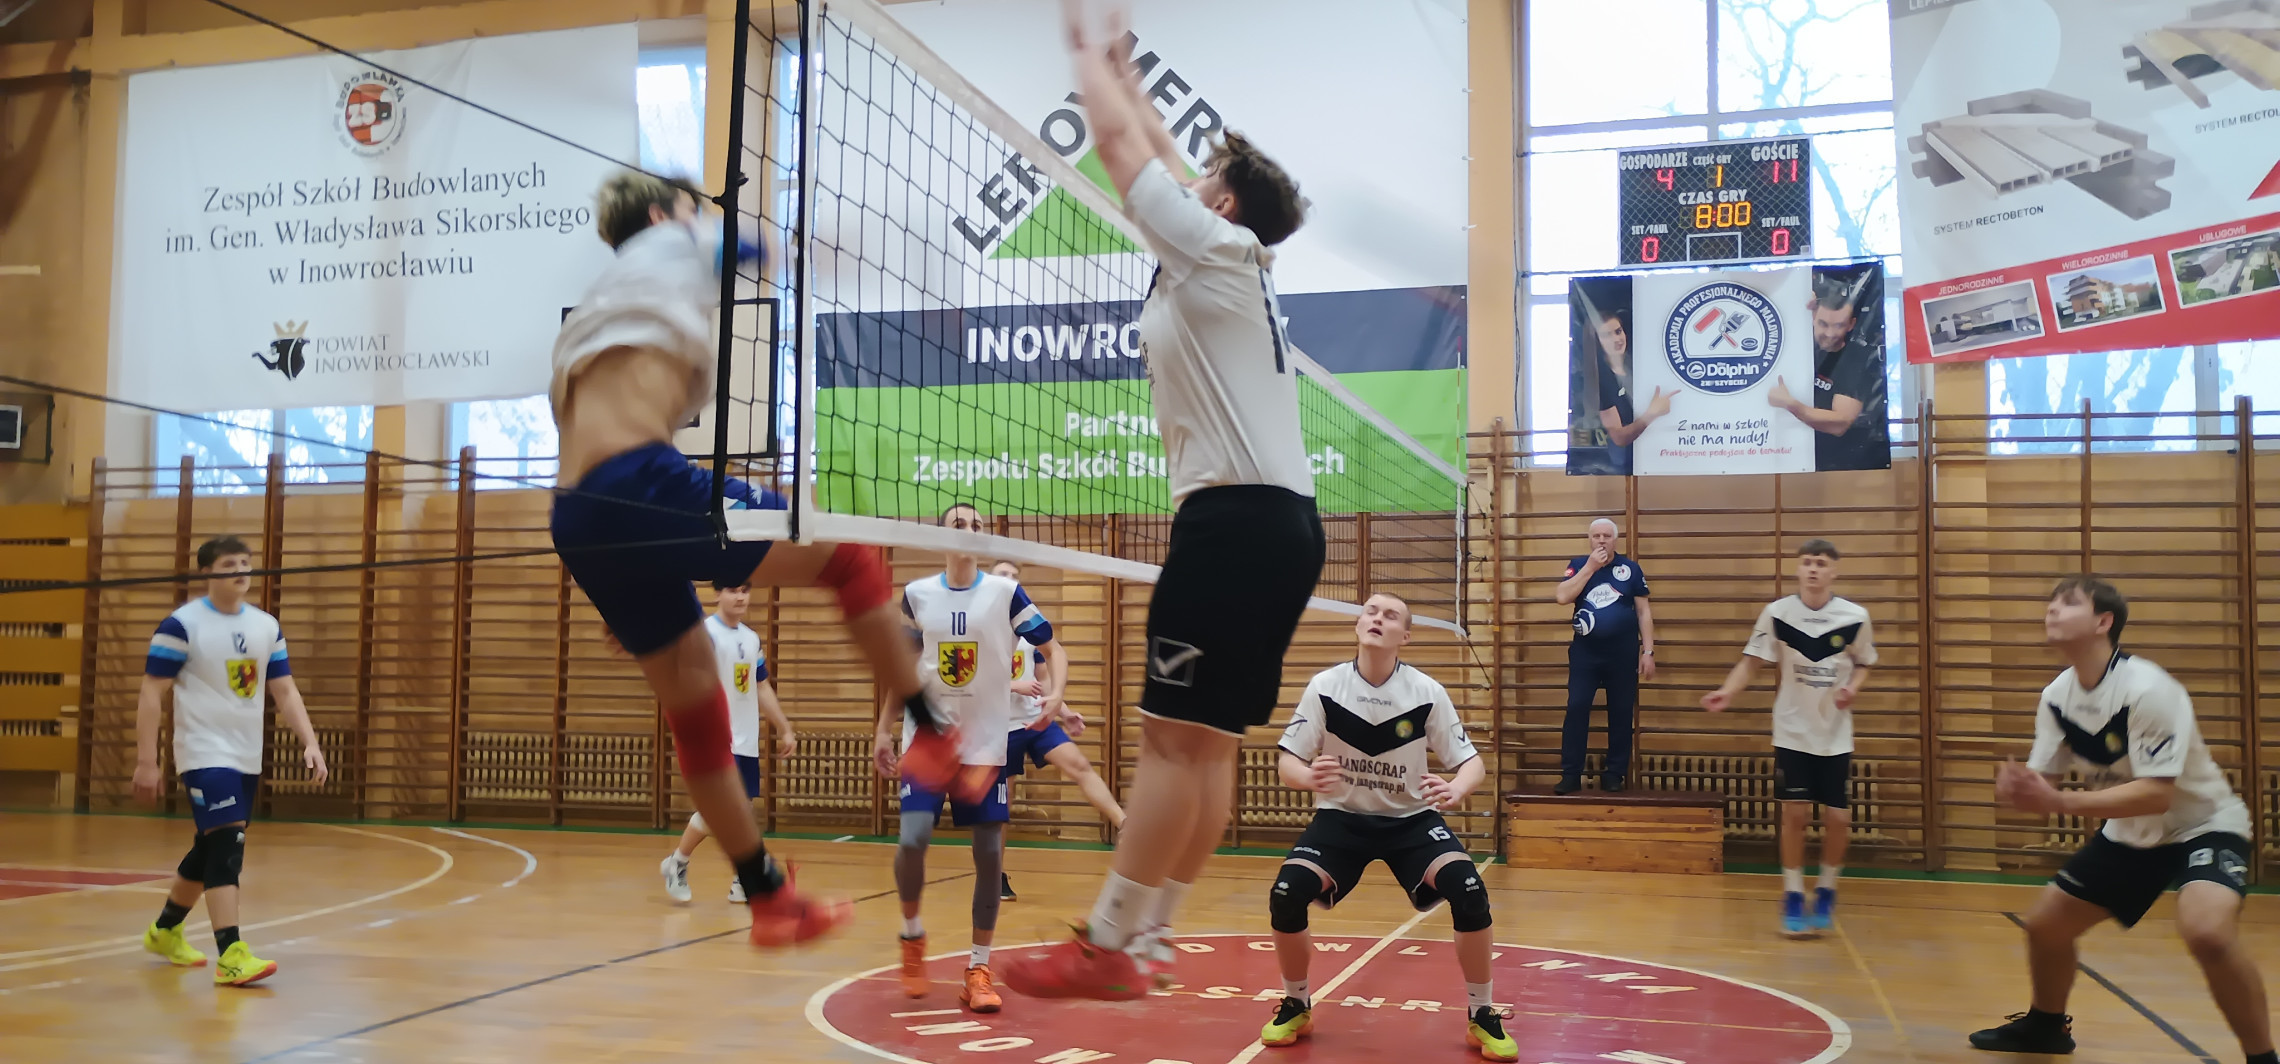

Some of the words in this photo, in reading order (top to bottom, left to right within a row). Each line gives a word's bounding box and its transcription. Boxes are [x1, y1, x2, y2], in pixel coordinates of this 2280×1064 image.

[2195, 117, 2237, 134] SYSTEM
[1620, 152, 1688, 171] GOSPODARZE
[1716, 154, 1732, 164] GRY
[1751, 142, 1799, 161] GOŚCIE
[952, 91, 1088, 253] LERO
[1656, 168, 1674, 191] 4
[1715, 165, 1723, 187] 1
[1772, 159, 1798, 183] 11
[204, 182, 284, 217] Zespół
[293, 176, 361, 206] Szkół
[373, 161, 546, 201] Budowlanych
[1678, 190, 1714, 205] CZAS
[1718, 189, 1748, 203] GRY
[1695, 201, 1751, 229] 8:00
[1761, 215, 1800, 228] SET/FAUL
[1934, 220, 1973, 235] SYSTEM
[1975, 205, 2044, 226] RECTOBETON
[166, 228, 201, 254] im.
[210, 223, 264, 251] Gen.
[275, 214, 425, 249] Władysława
[436, 202, 591, 234] Sikorskiego
[1631, 223, 1669, 236] SET/FAUL
[1641, 236, 1660, 263] 0
[1771, 228, 1790, 255] 0
[269, 266, 289, 285] w
[300, 247, 474, 284] Inowrocławiu
[2061, 250, 2129, 271] WIELORODZINNE
[1938, 275, 2005, 296] JEDNORODZINNE
[1669, 316, 1685, 364] AKADEMIA
[1679, 286, 1763, 316] PROFESJONALNEGO
[1760, 306, 1779, 361] MALOWANIA
[316, 334, 391, 354] POWIAT
[315, 349, 490, 374] INOWROCŁAWSKI
[1707, 363, 1760, 378] Dolphin
[1691, 421, 1719, 431] nami
[1723, 422, 1731, 430] w
[1735, 418, 1769, 430] szkole
[1678, 434, 1696, 446] nie
[1701, 434, 1724, 446] ma
[1730, 430, 1770, 446] nudy!
[913, 450, 1029, 486] Zespołu
[1037, 450, 1120, 480] Szkół
[951, 611, 967, 636] 10
[997, 783, 1007, 804] 10
[1428, 825, 1451, 842] 15
